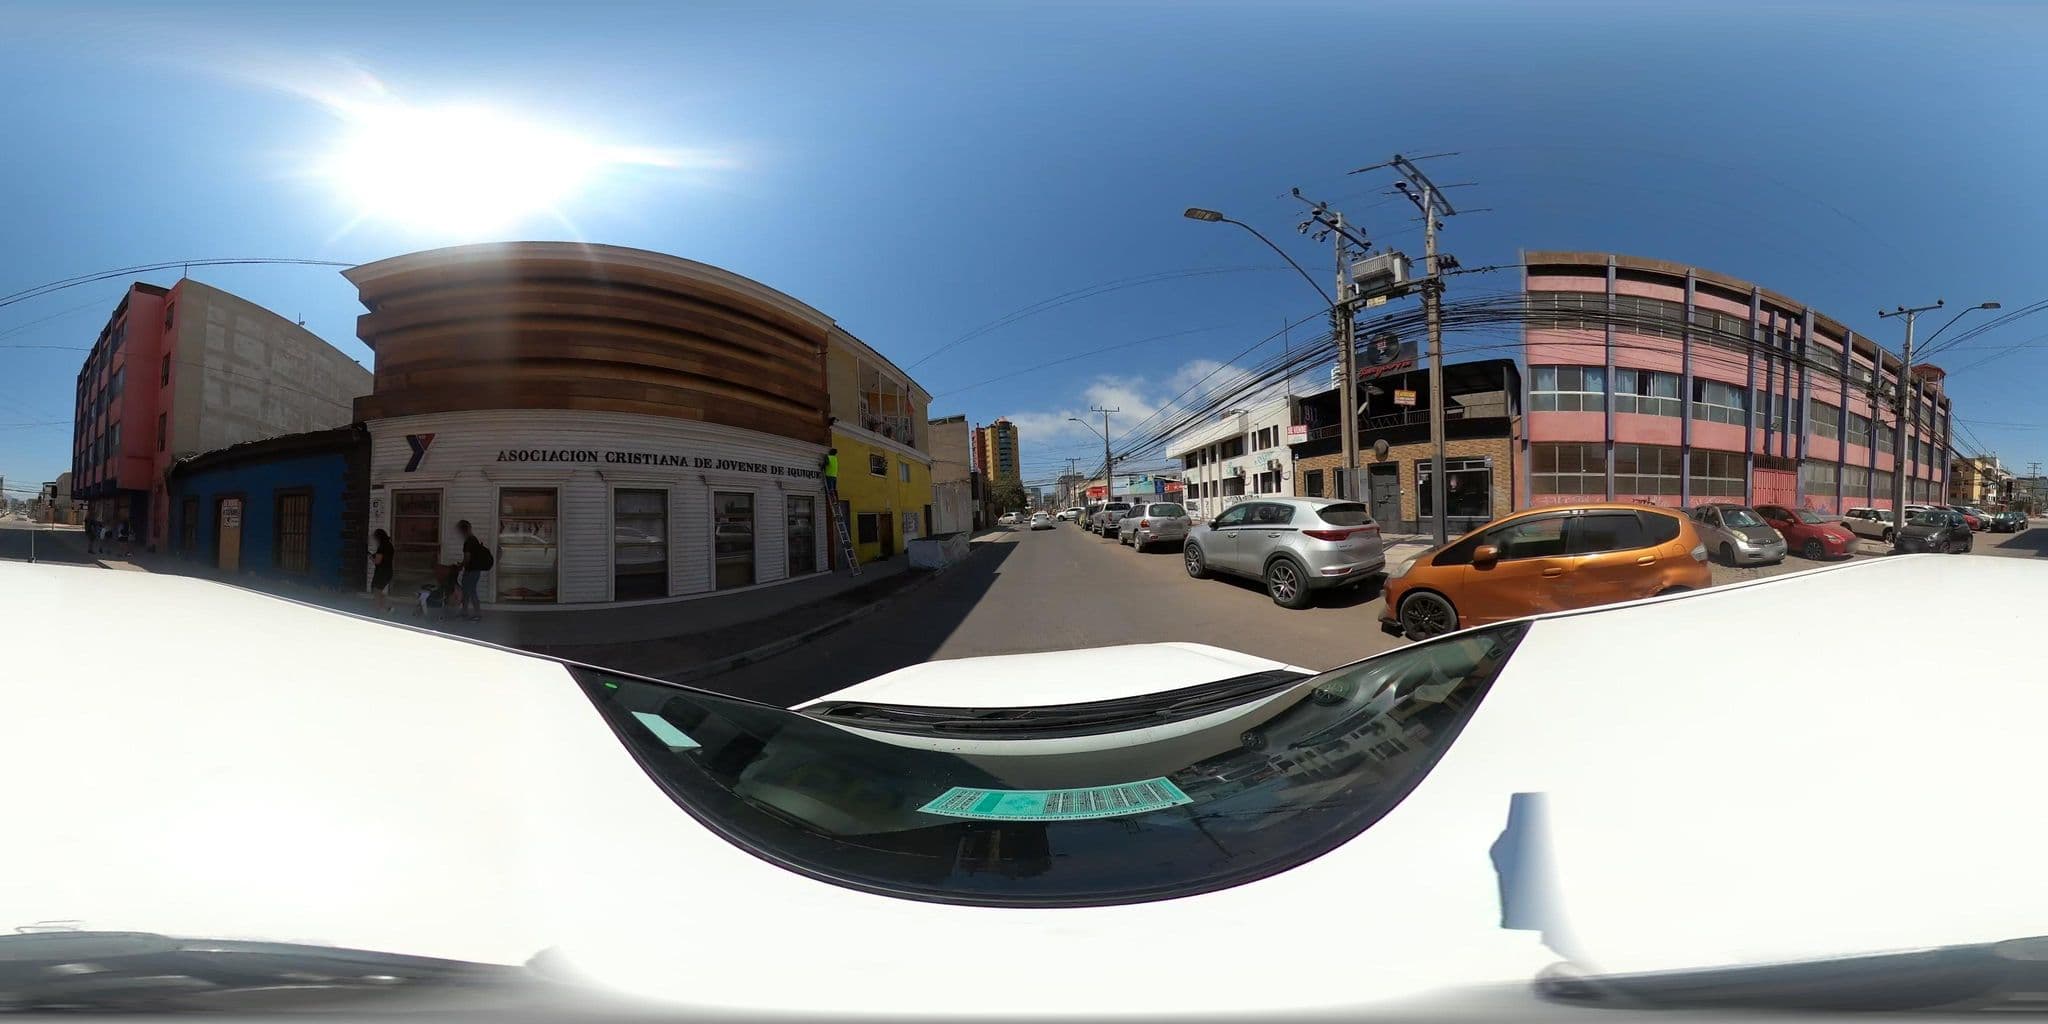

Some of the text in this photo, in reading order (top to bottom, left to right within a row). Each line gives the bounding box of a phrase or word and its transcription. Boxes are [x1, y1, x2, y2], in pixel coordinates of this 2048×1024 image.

[496, 449, 599, 463] ASOCIACION
[605, 452, 689, 467] CRISTIANA
[694, 457, 712, 469] DE
[716, 460, 768, 474] JOVENES
[770, 465, 785, 476] DE
